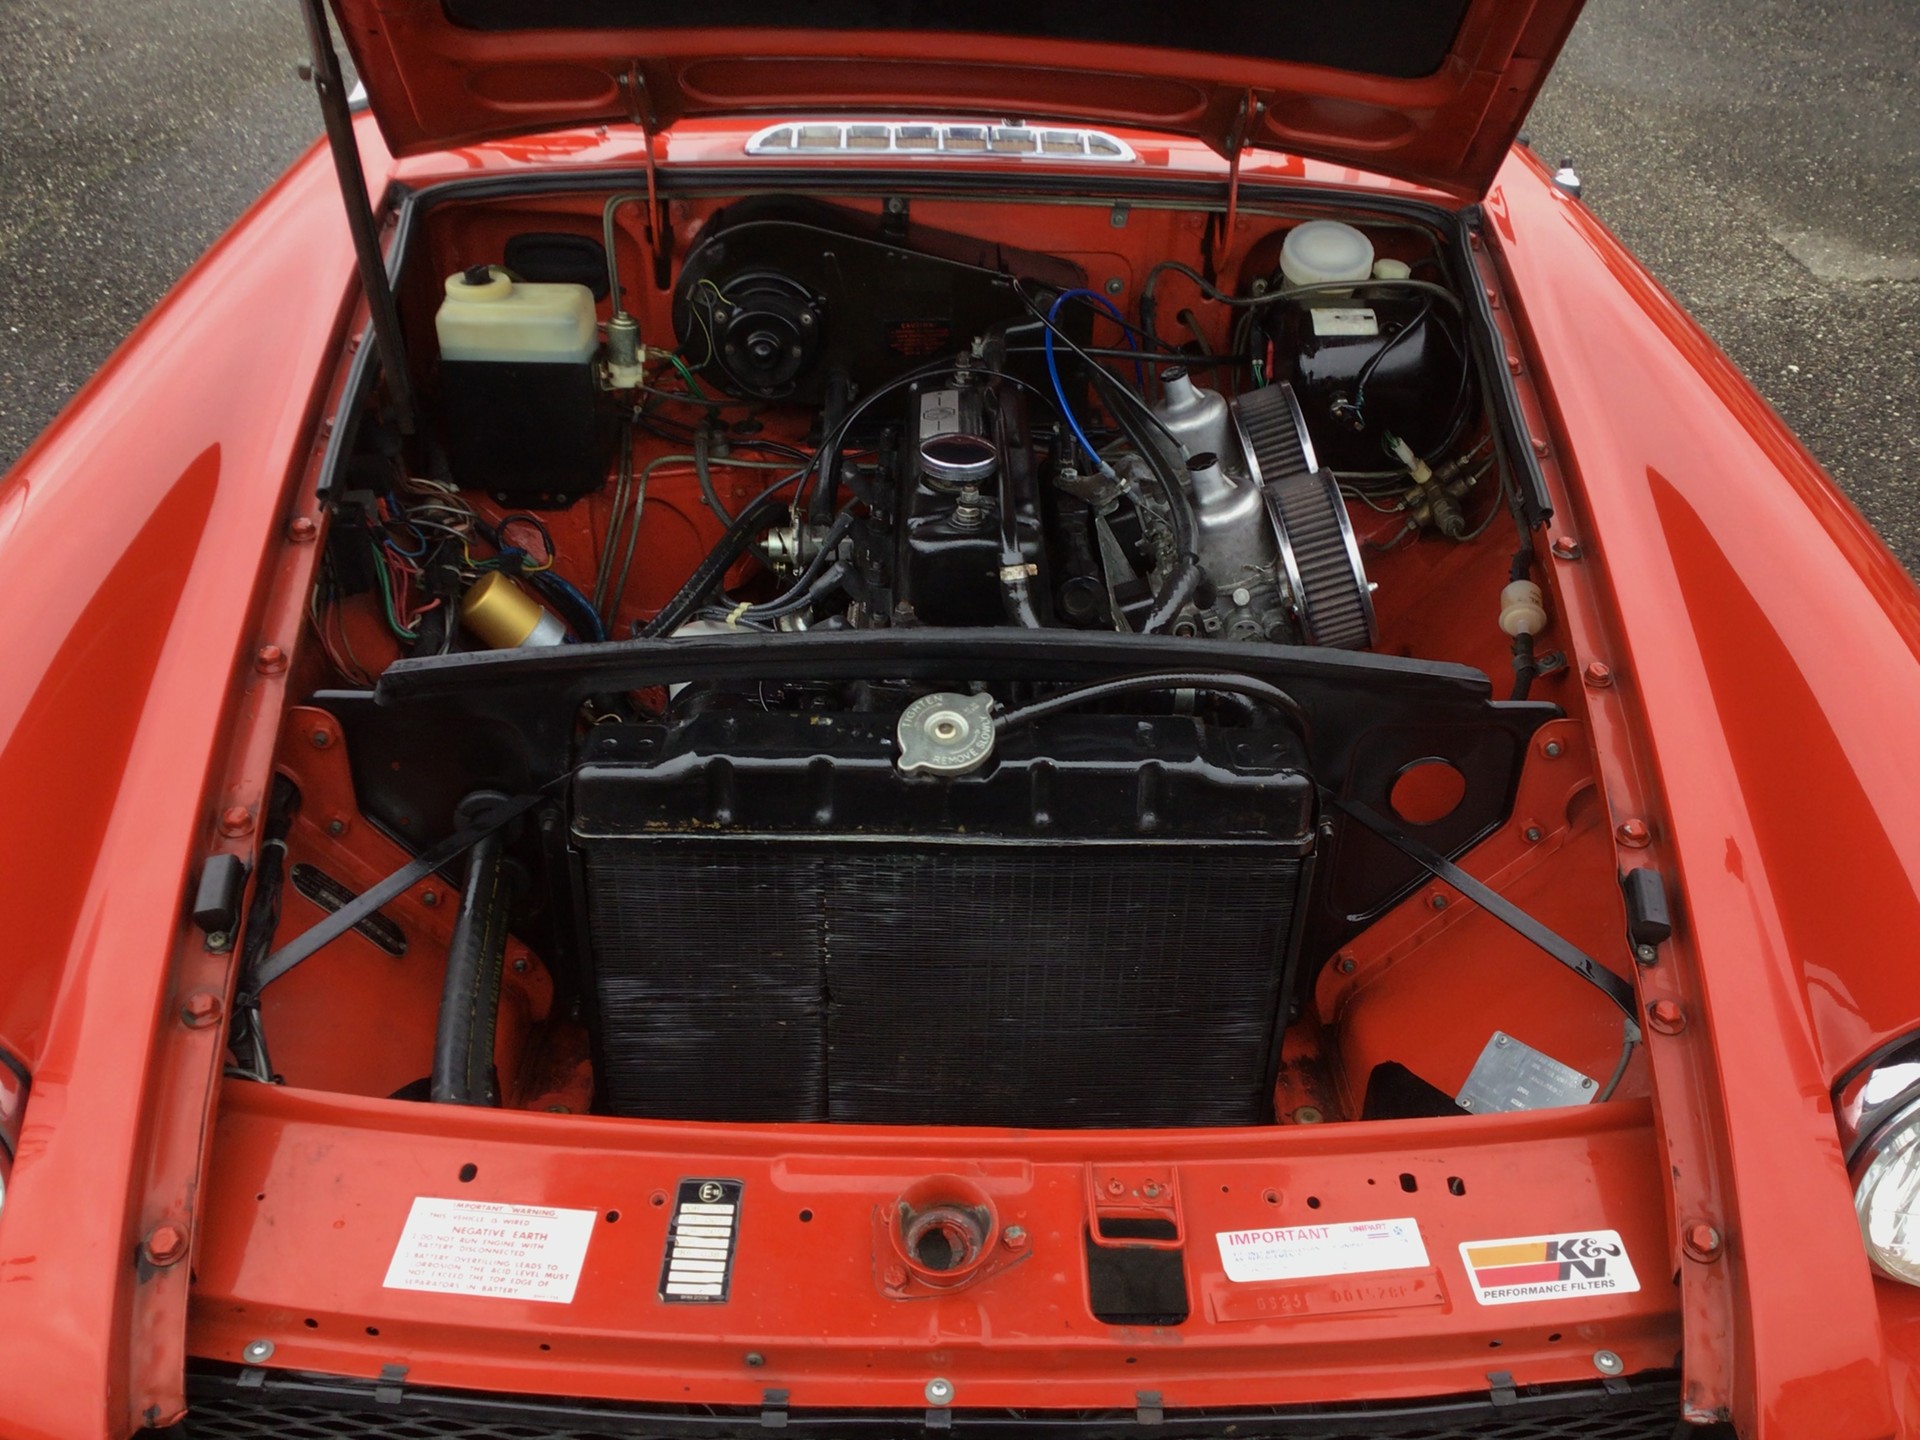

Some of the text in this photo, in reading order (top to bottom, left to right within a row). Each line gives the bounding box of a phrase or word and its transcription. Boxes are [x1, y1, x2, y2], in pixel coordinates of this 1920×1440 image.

[902, 694, 943, 727] TIGHTEN
[933, 714, 991, 765] REMOVE SLOWLY
[453, 1203, 556, 1217] IMPORTANT WARNING
[452, 1226, 548, 1241] NEGATIVE EARTH
[1349, 1223, 1388, 1234] UNIPART
[437, 1235, 455, 1243] NOT
[460, 1237, 477, 1245] RUN
[483, 1239, 515, 1248] ENGINE
[521, 1242, 545, 1250] WITH
[1229, 1227, 1330, 1246] IMPORTANT
[460, 1245, 526, 1257] DISCONNECTED
[455, 1256, 510, 1267] OVERFILLING
[516, 1261, 542, 1270] LEADS
[491, 1266, 511, 1275] ACID
[516, 1269, 539, 1277] LEVEL
[544, 1272, 569, 1280] MUST
[490, 1275, 505, 1283] TOP
[510, 1278, 532, 1287] EDGE
[482, 1286, 518, 1294] BATTERY
[1484, 1279, 1615, 1299] PERFORMANCE FILTERS
